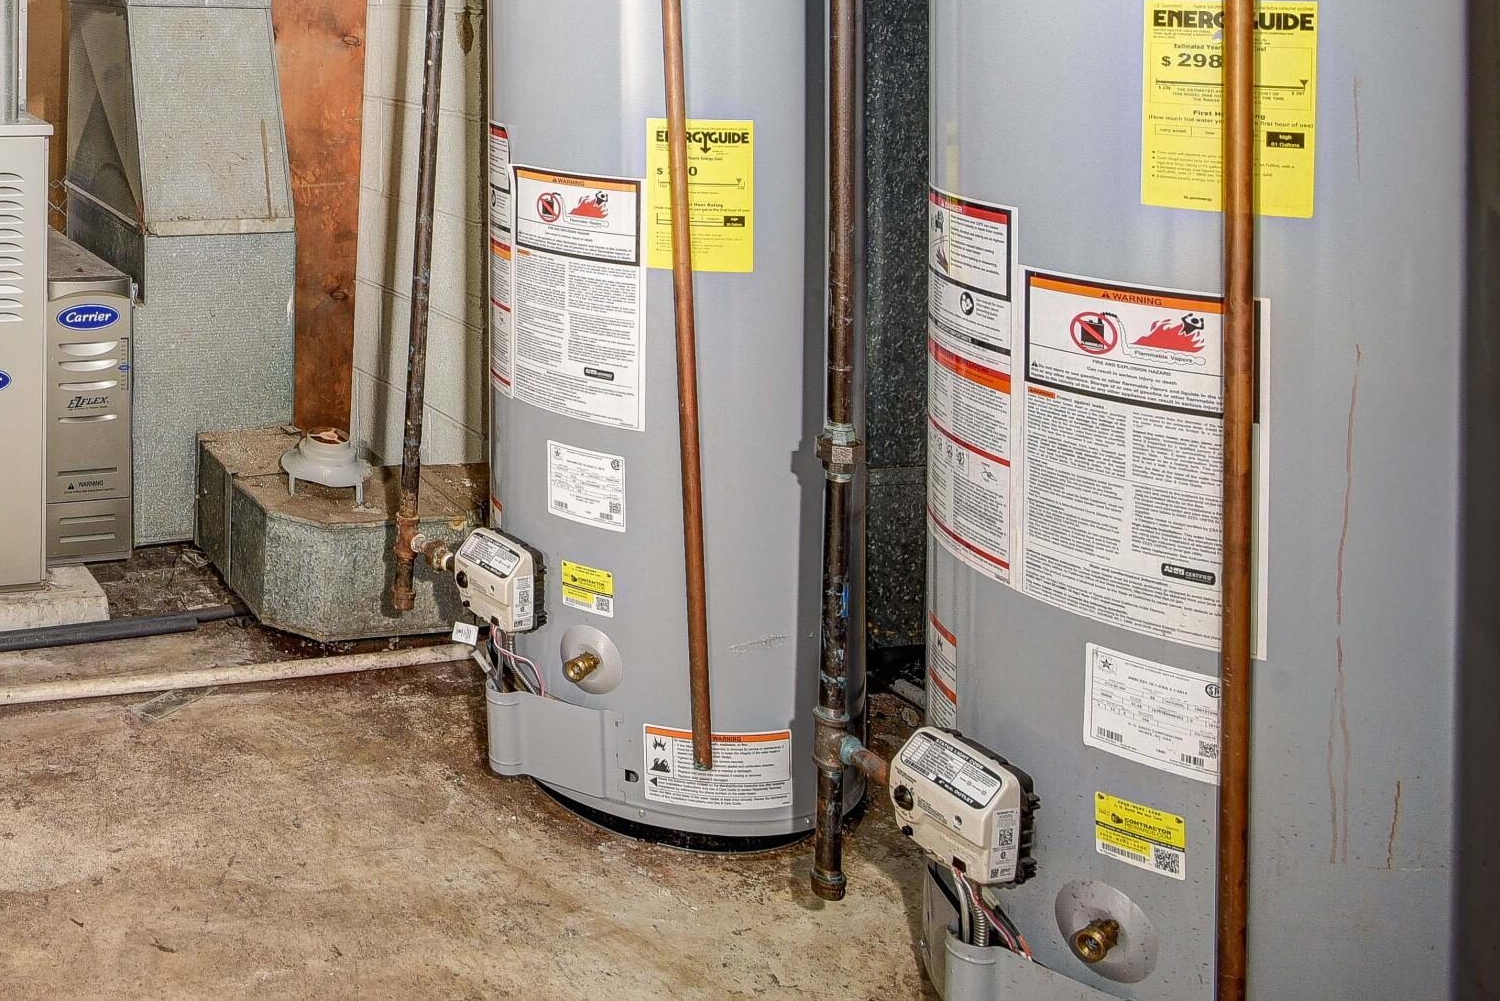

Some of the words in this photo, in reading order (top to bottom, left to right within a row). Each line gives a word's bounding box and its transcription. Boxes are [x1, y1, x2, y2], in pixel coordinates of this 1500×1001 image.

[1161, 55, 1171, 67] $
[558, 178, 584, 187] WARNING
[1112, 292, 1162, 306] WARNING
[66, 311, 111, 324] Carrier
[1134, 349, 1168, 360] Flammable
[1170, 355, 1193, 363] Vapors
[1124, 817, 1171, 835] CONTRACTOR
